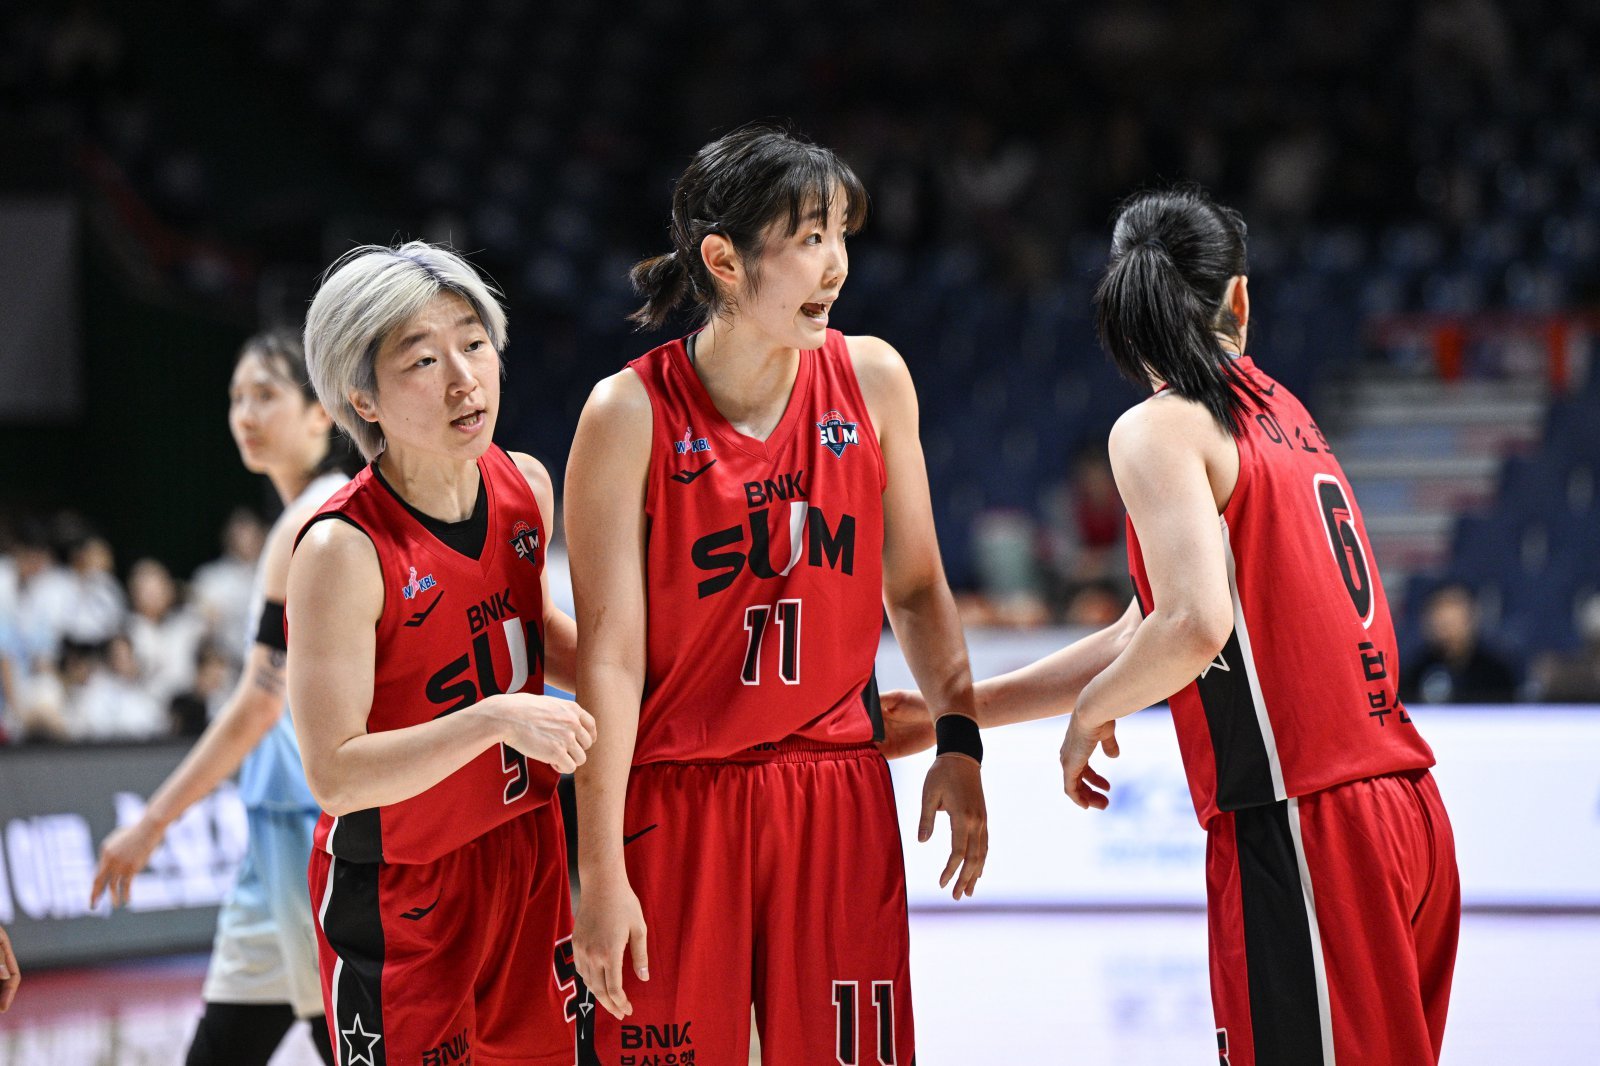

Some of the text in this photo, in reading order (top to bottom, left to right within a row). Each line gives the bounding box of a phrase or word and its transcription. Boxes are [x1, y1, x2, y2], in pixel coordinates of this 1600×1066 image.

[820, 425, 859, 445] SUM
[743, 470, 808, 509] BNK
[514, 534, 540, 559] SUM
[691, 500, 856, 600] SUM
[1312, 472, 1375, 630] 6
[466, 587, 517, 635] BNK
[740, 598, 802, 686] 11
[620, 1021, 693, 1050] BNK
[831, 979, 898, 1066] 11
